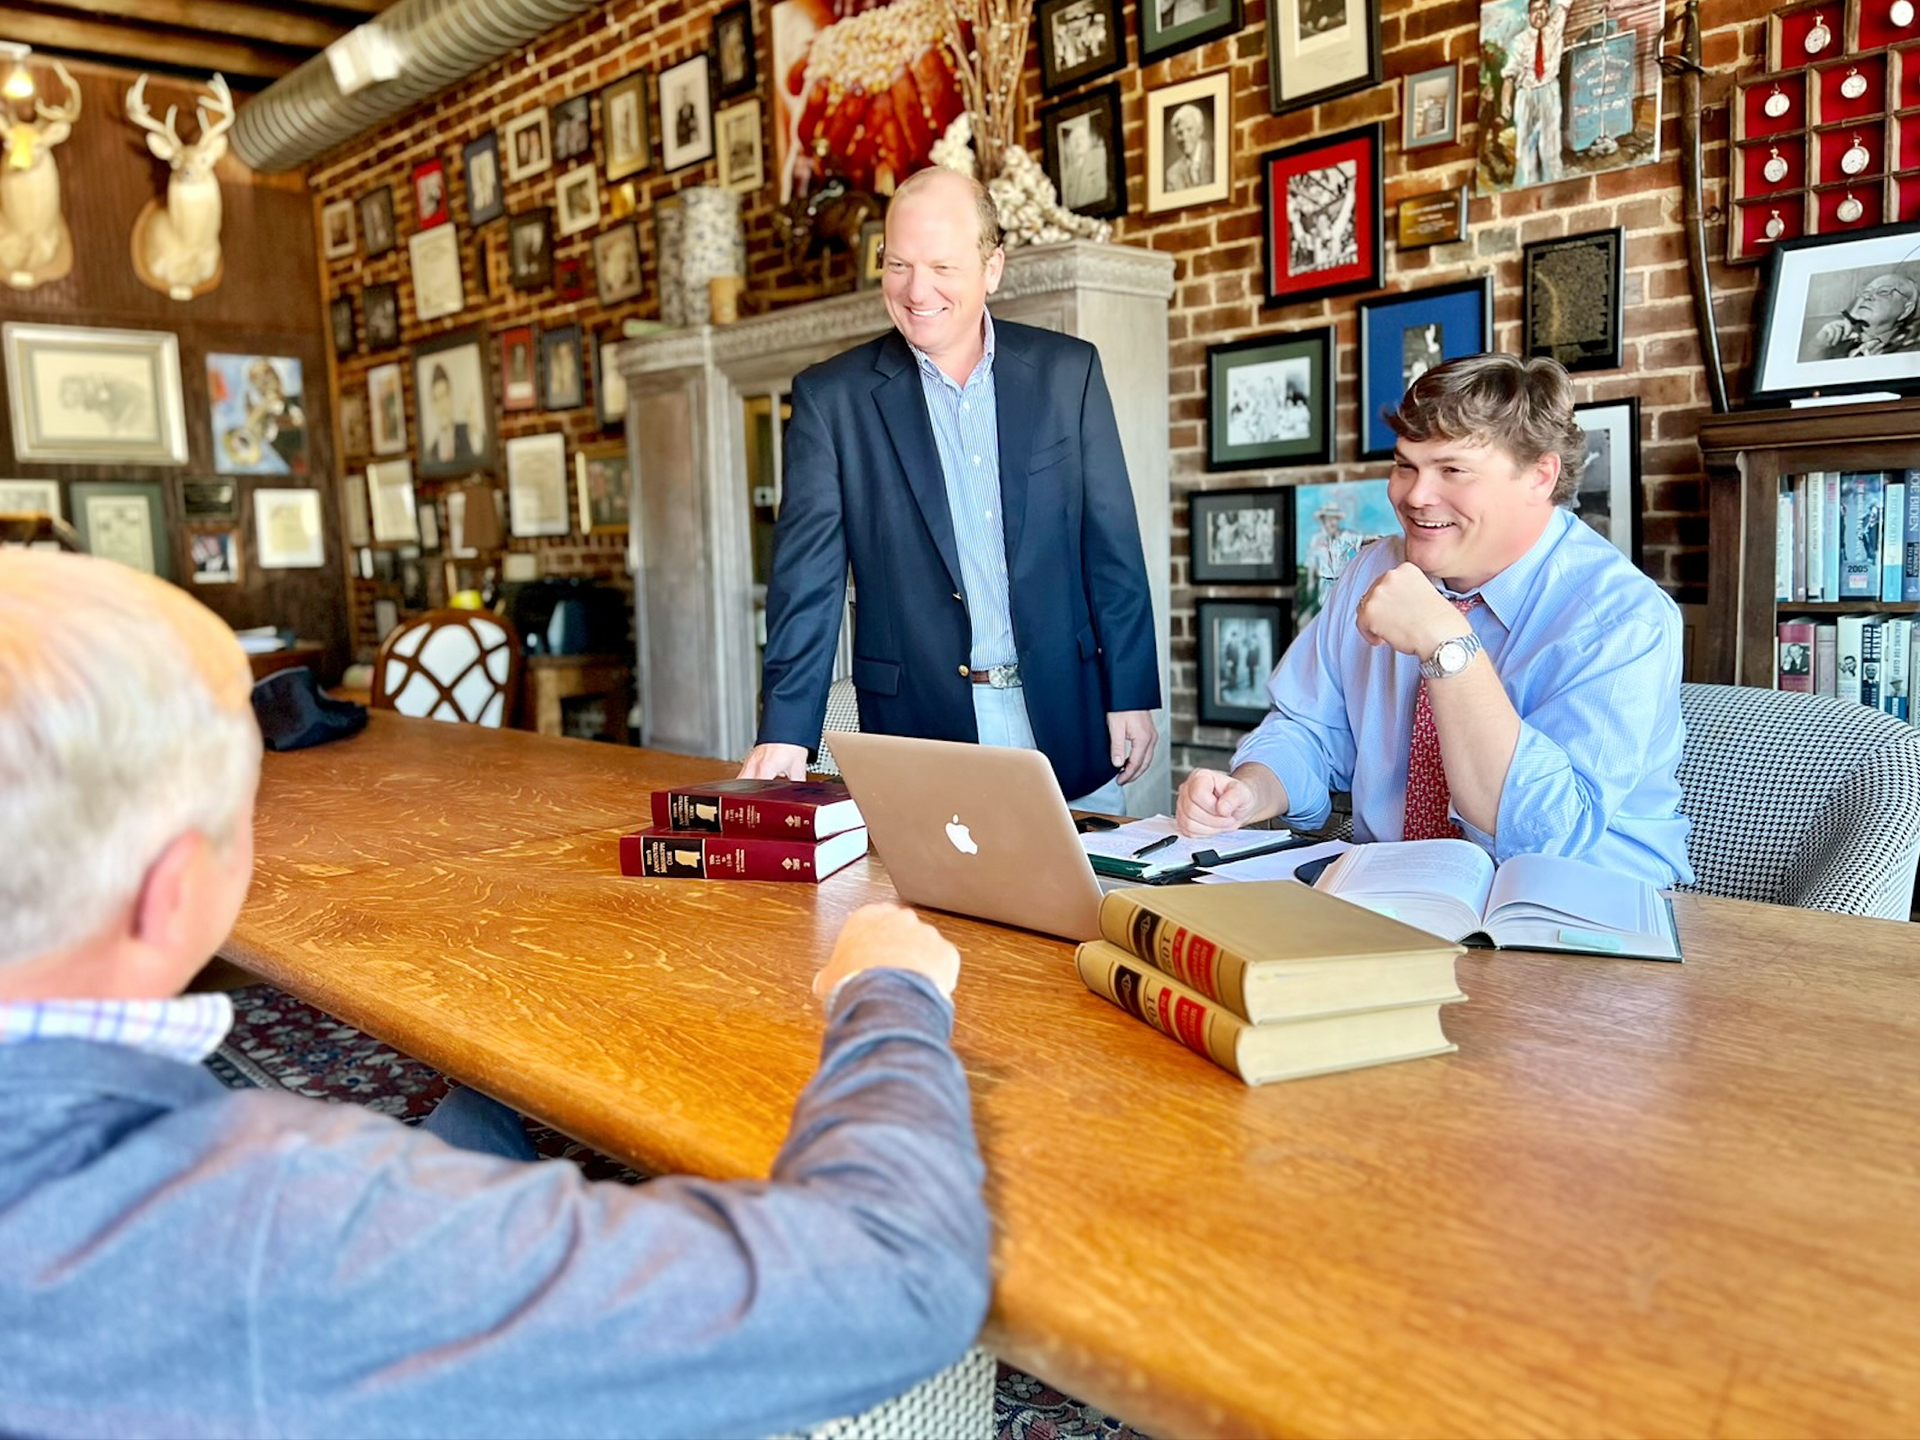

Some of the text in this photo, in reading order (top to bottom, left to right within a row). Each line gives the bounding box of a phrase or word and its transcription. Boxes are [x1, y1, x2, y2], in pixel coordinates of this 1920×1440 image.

[1909, 472, 1920, 532] JOE BIDEN
[1847, 565, 1868, 573] 2005
[1863, 627, 1871, 659] CHARGE
[1872, 627, 1881, 658] TAKING
